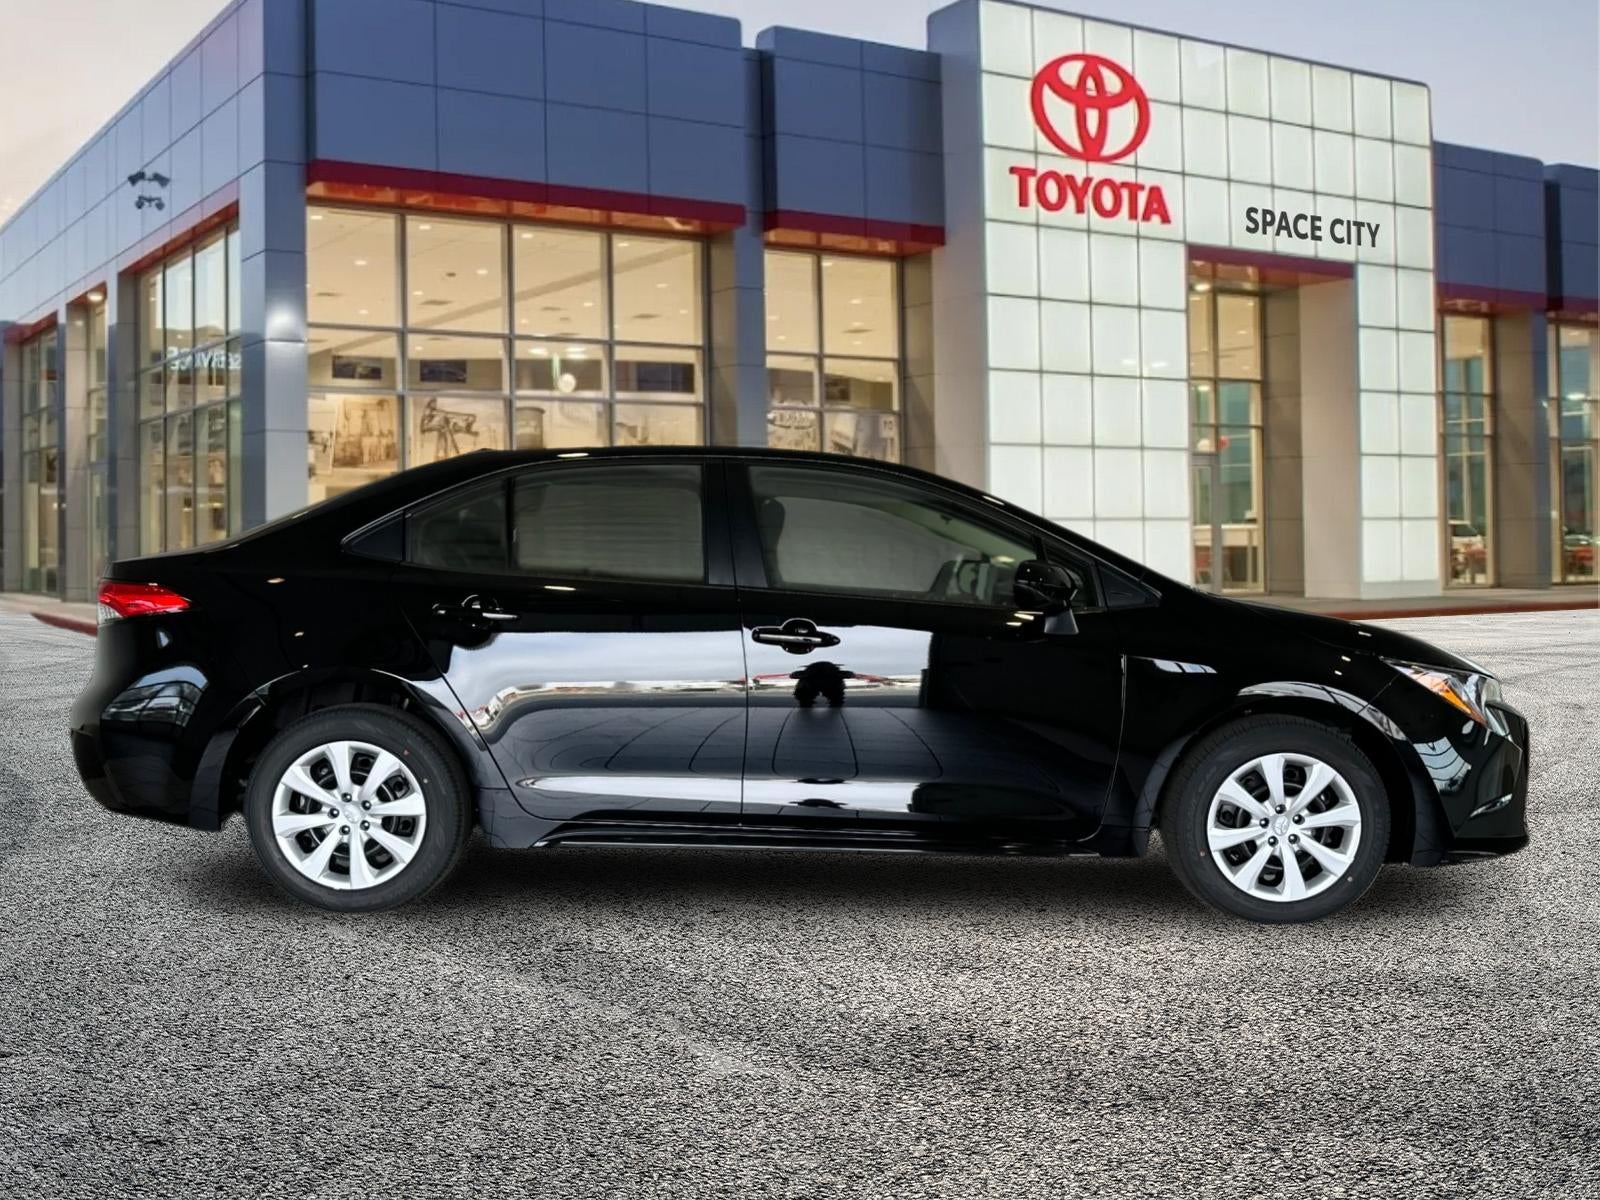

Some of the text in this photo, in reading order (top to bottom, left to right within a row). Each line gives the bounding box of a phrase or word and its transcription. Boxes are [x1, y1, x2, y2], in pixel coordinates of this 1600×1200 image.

[1009, 166, 1171, 224] TOYOTA
[1245, 207, 1380, 248] SPACE CITY
